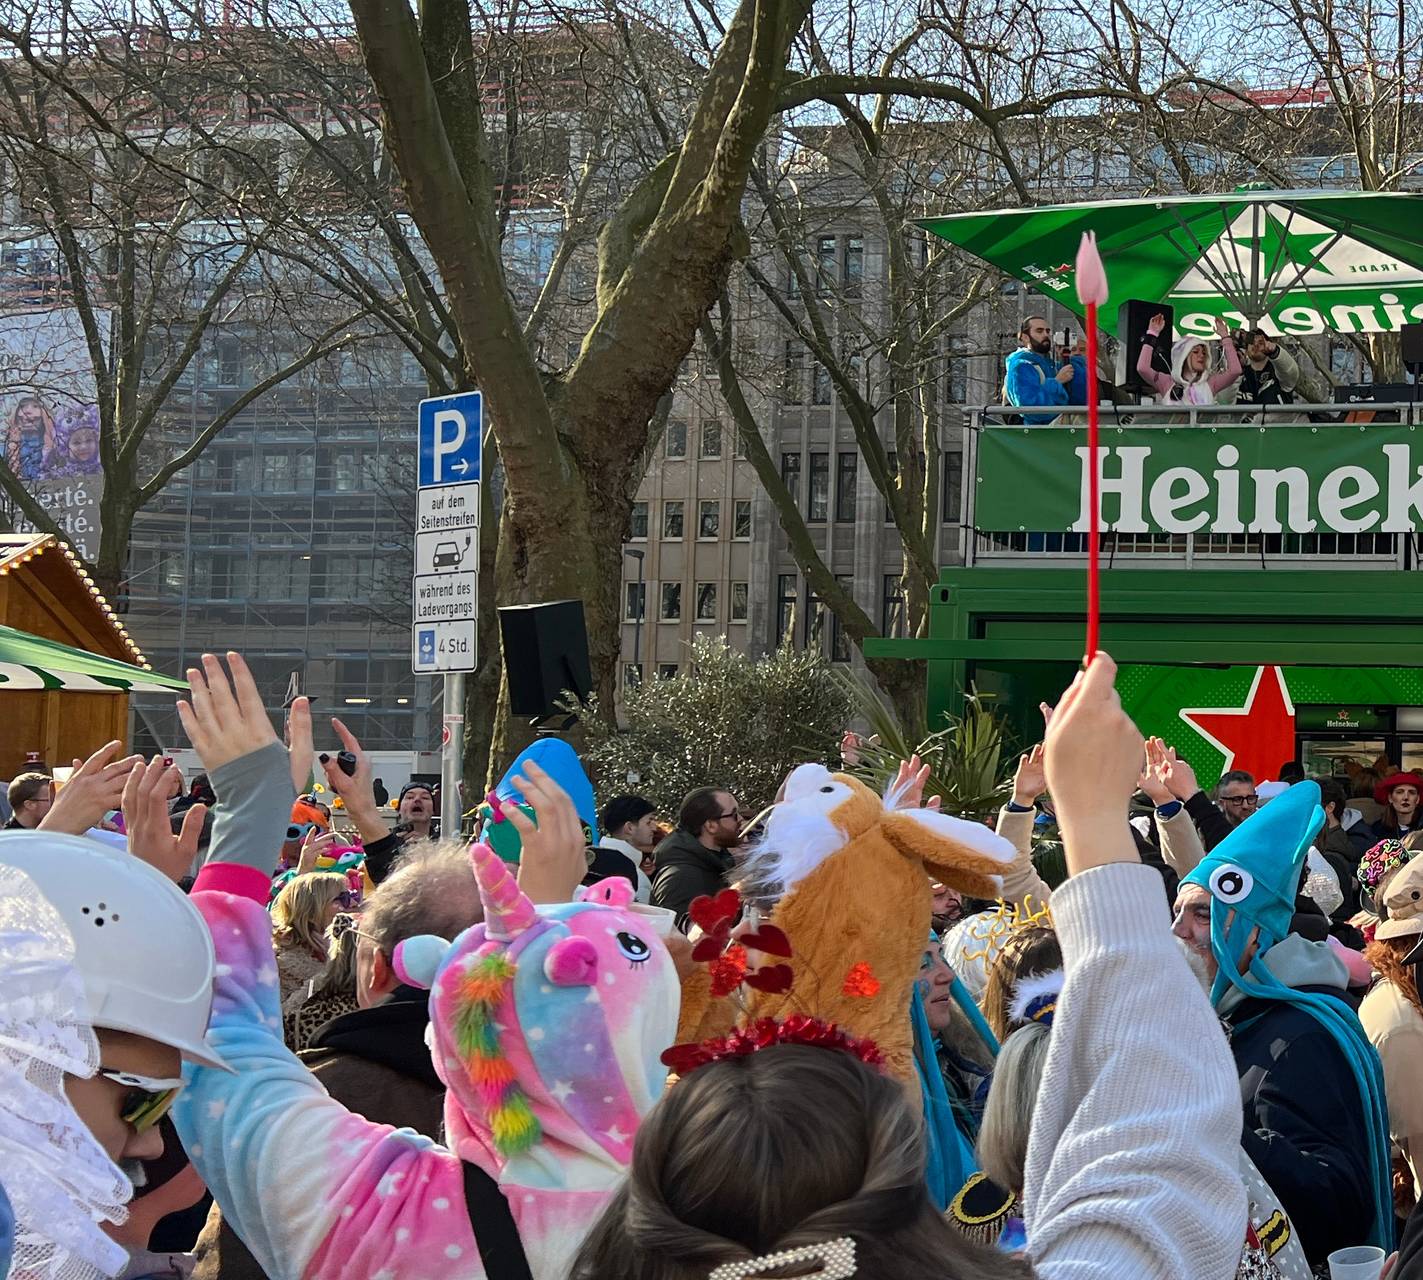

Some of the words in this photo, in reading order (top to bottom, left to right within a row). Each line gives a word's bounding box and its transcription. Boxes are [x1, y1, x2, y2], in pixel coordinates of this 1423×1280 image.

[433, 409, 467, 482] P
[431, 496, 445, 510] auf
[448, 494, 465, 508] dem
[421, 513, 475, 529] Seitenstreifen
[419, 582, 454, 599] während
[457, 582, 471, 596] des
[418, 602, 473, 618] Ladevorgangs
[438, 638, 445, 653] 4
[448, 637, 470, 653] Std.
[1327, 719, 1359, 728] Heineken
